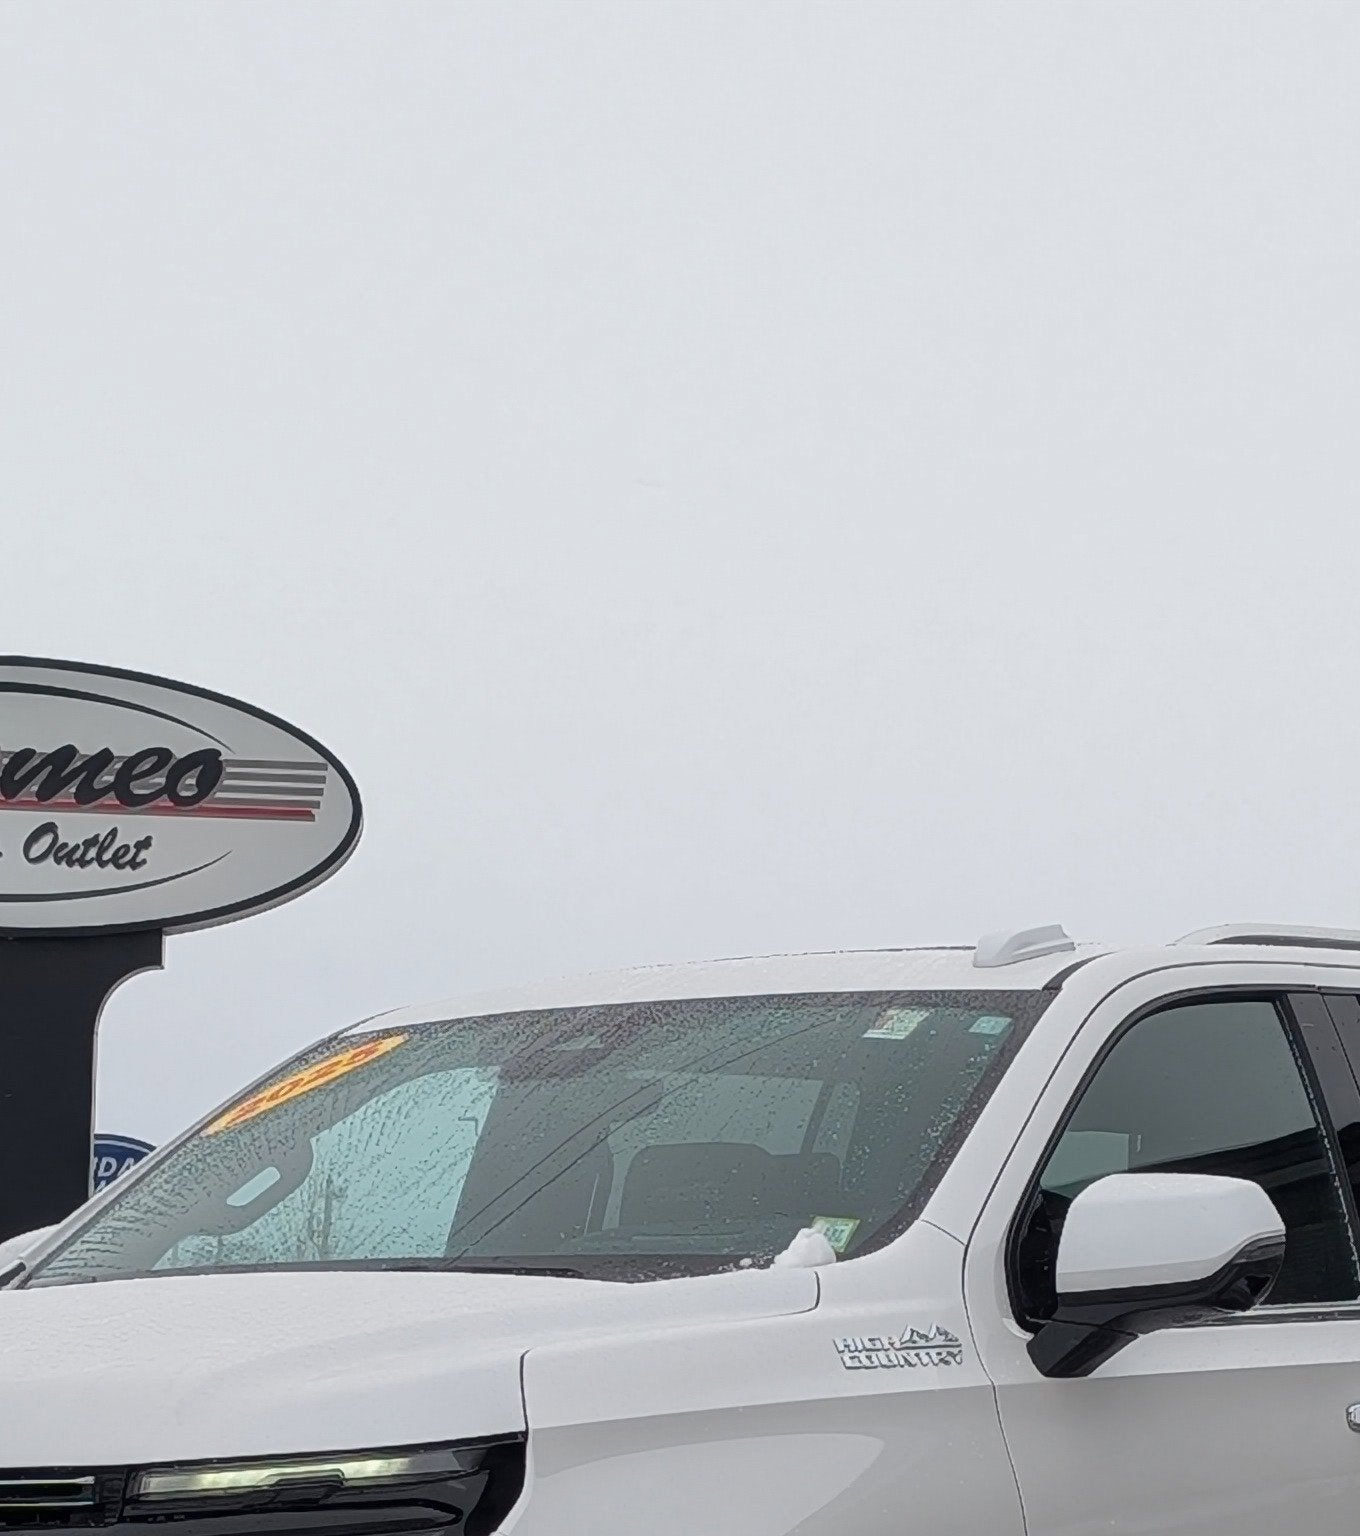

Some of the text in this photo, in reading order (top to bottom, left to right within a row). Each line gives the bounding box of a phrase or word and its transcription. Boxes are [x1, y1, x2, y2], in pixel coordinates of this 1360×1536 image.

[22, 826, 154, 872] Outlet
[832, 1336, 901, 1353] HIGH
[840, 1349, 963, 1370] COUNTRY
